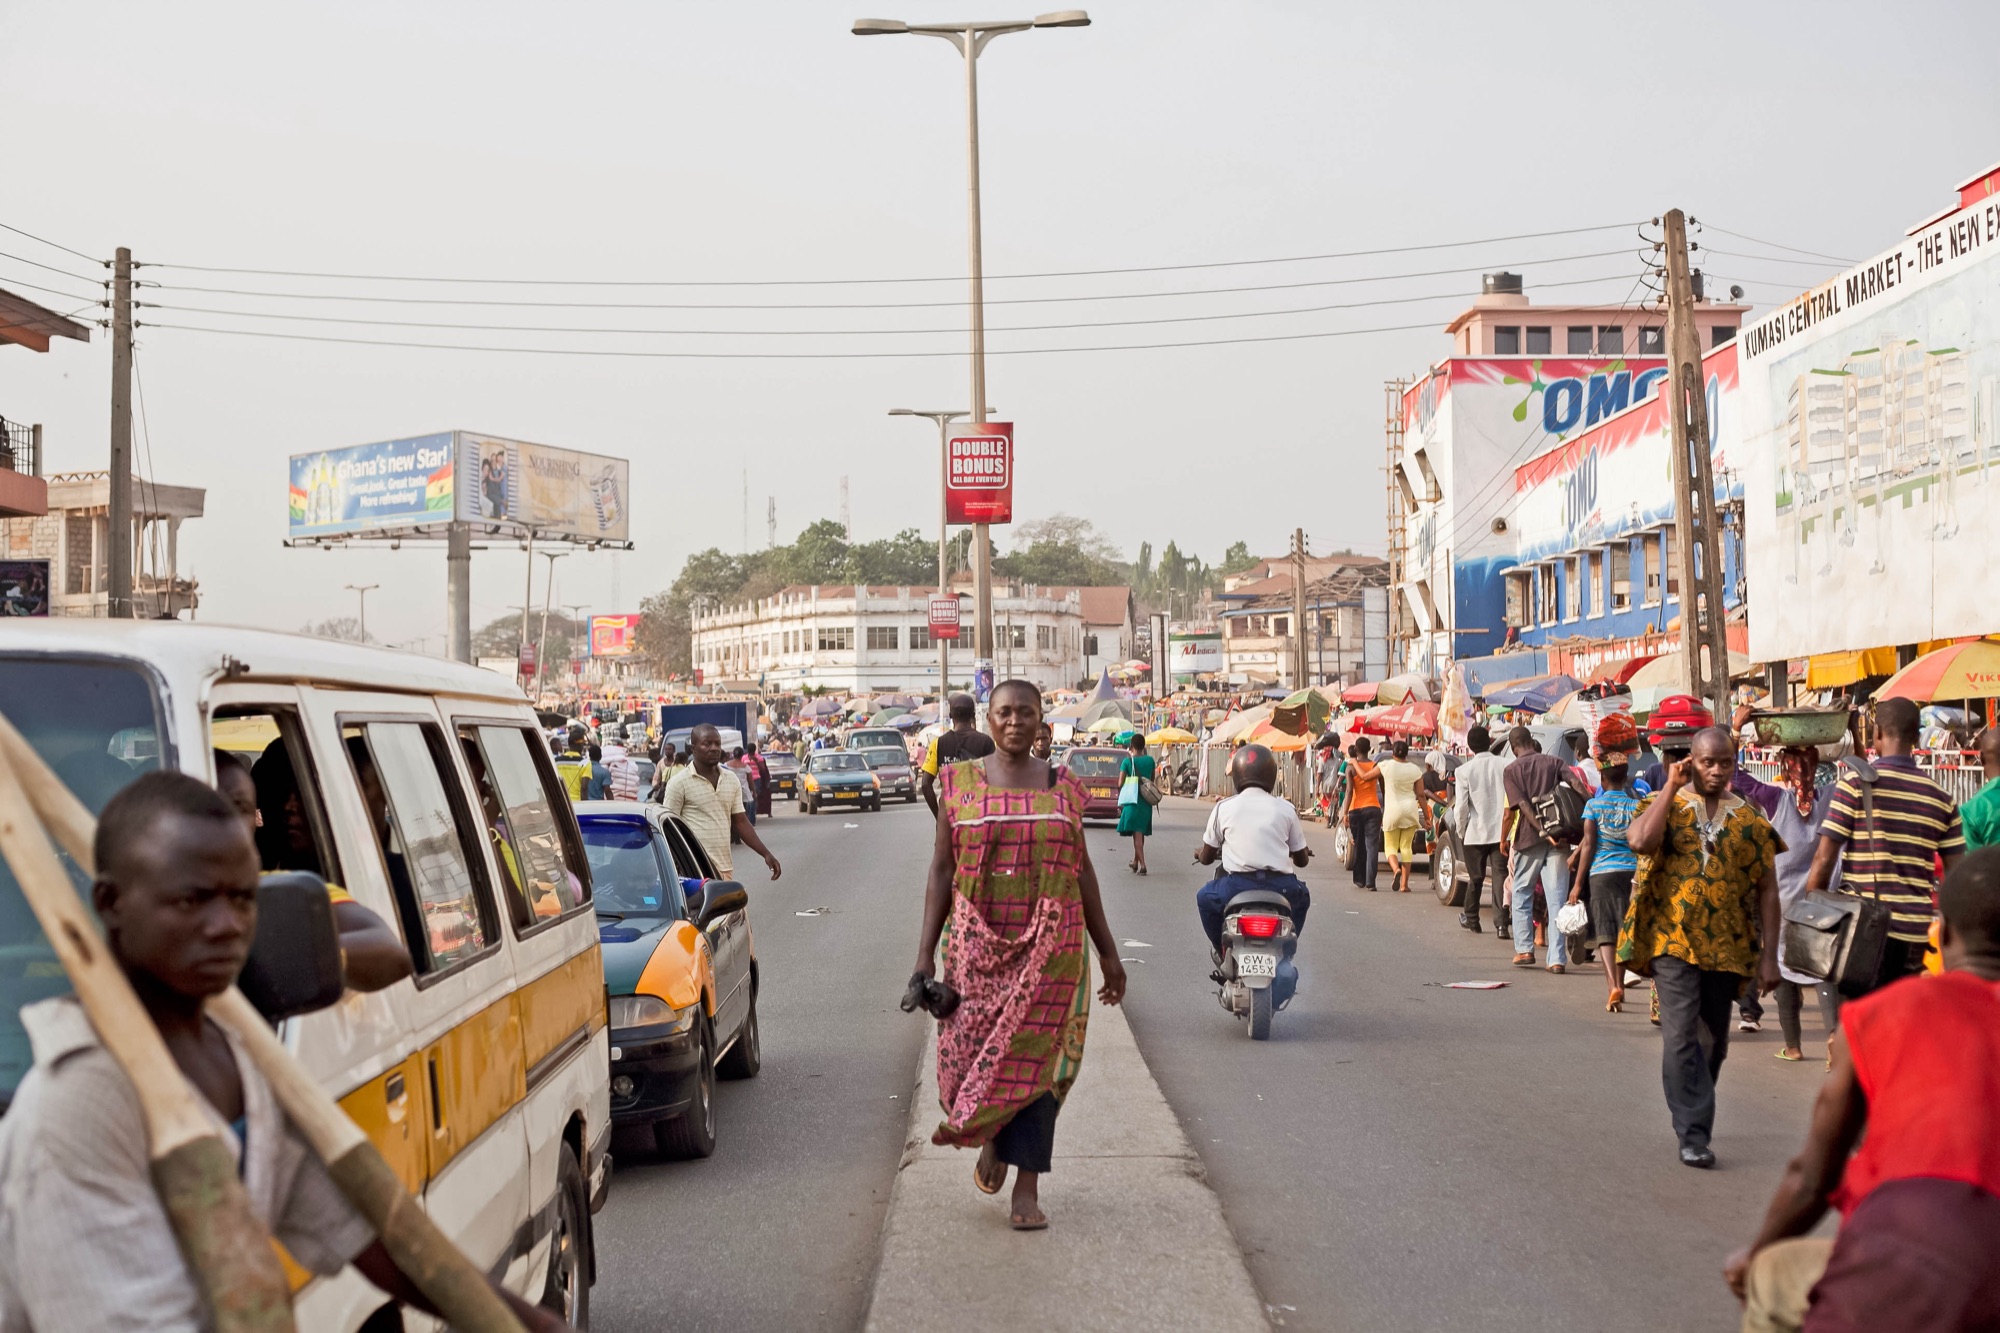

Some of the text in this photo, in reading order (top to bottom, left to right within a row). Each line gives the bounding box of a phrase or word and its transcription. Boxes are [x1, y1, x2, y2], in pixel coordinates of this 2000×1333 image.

[1744, 314, 1786, 360] KUMASI
[1788, 285, 1841, 337] CENTRAL
[1846, 251, 1903, 309] MARKET
[1917, 231, 1944, 273] THE
[1949, 213, 1980, 260] NEW
[952, 441, 1004, 456] DOUBLE
[338, 445, 448, 478] Ghana's new Star!
[952, 458, 1004, 474] BONUS
[387, 477, 407, 490] Great
[1567, 444, 1597, 534] OMO
[932, 601, 956, 609] DOUBLE
[932, 609, 956, 618] BONUS
